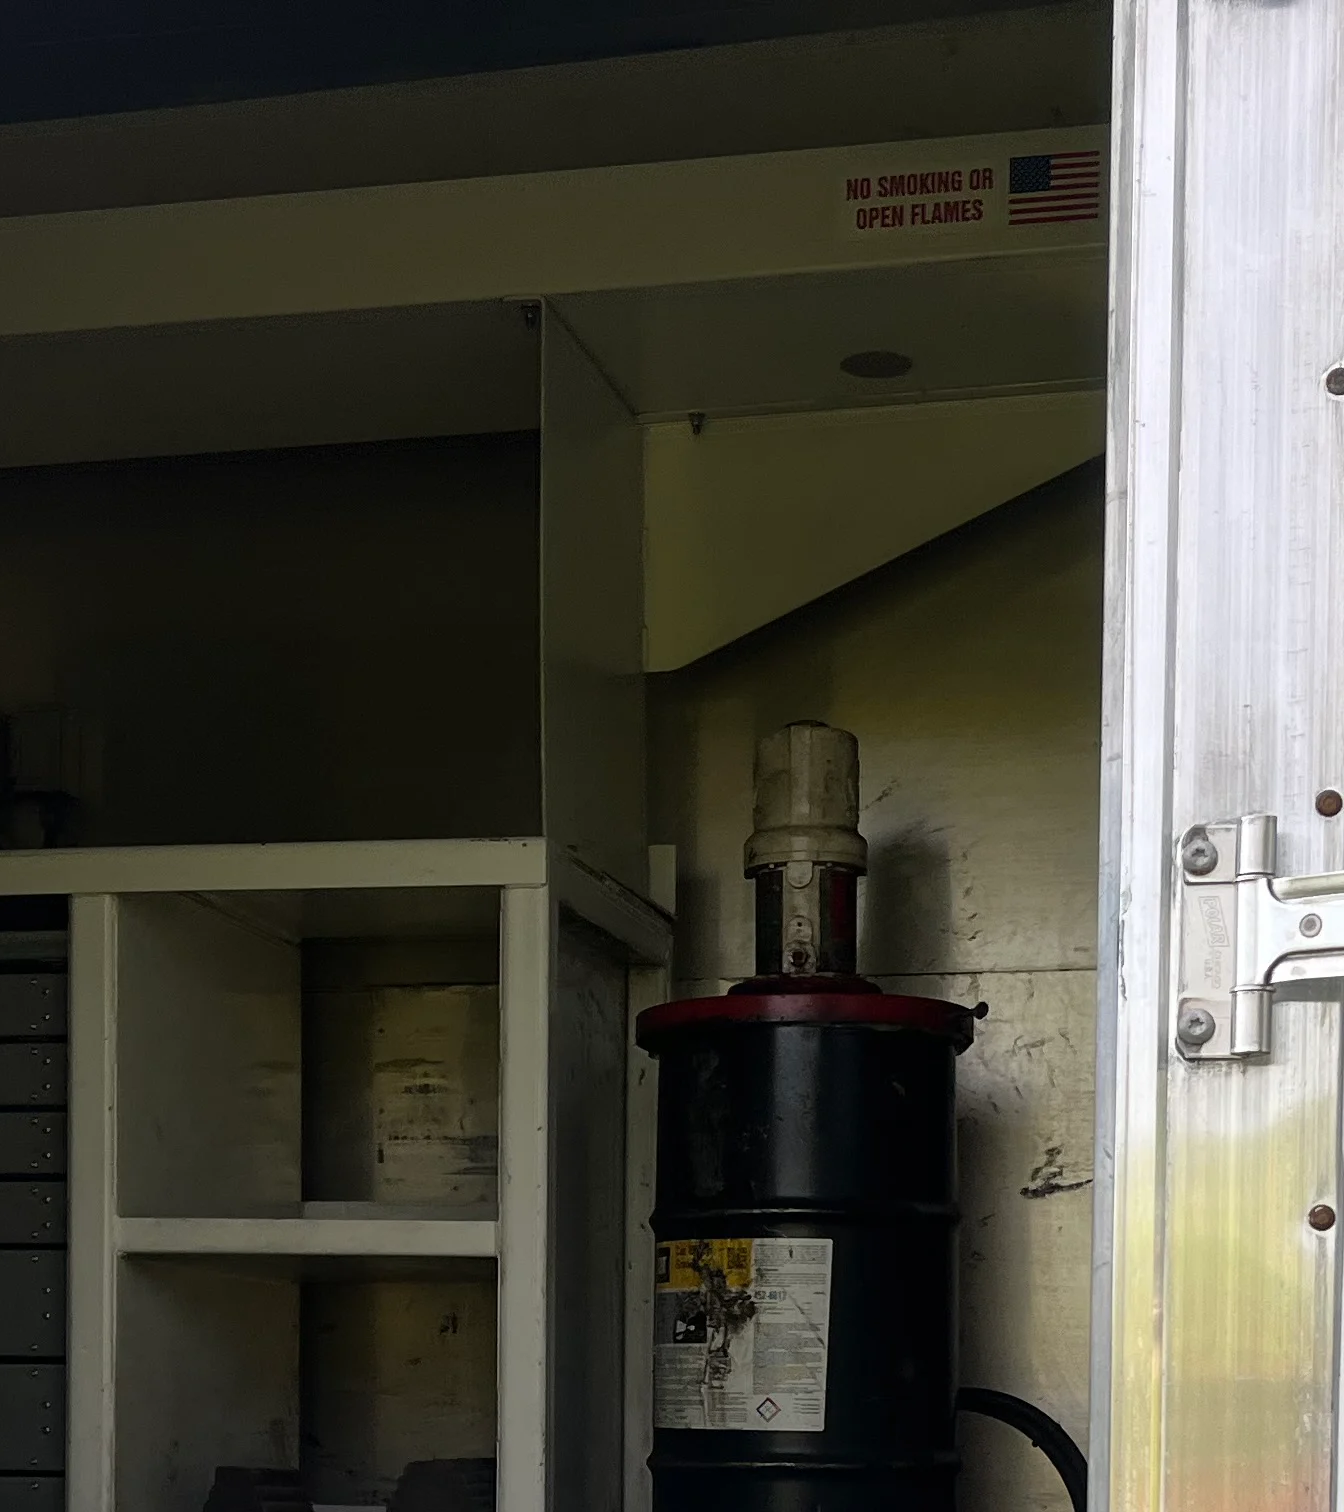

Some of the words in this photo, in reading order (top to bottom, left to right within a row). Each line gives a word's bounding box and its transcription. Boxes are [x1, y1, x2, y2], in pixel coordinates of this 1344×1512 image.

[846, 177, 871, 201] NO
[877, 171, 963, 198] SMOKING
[969, 167, 994, 191] OR
[856, 204, 904, 230] OPEN
[910, 199, 984, 226] FLAMES
